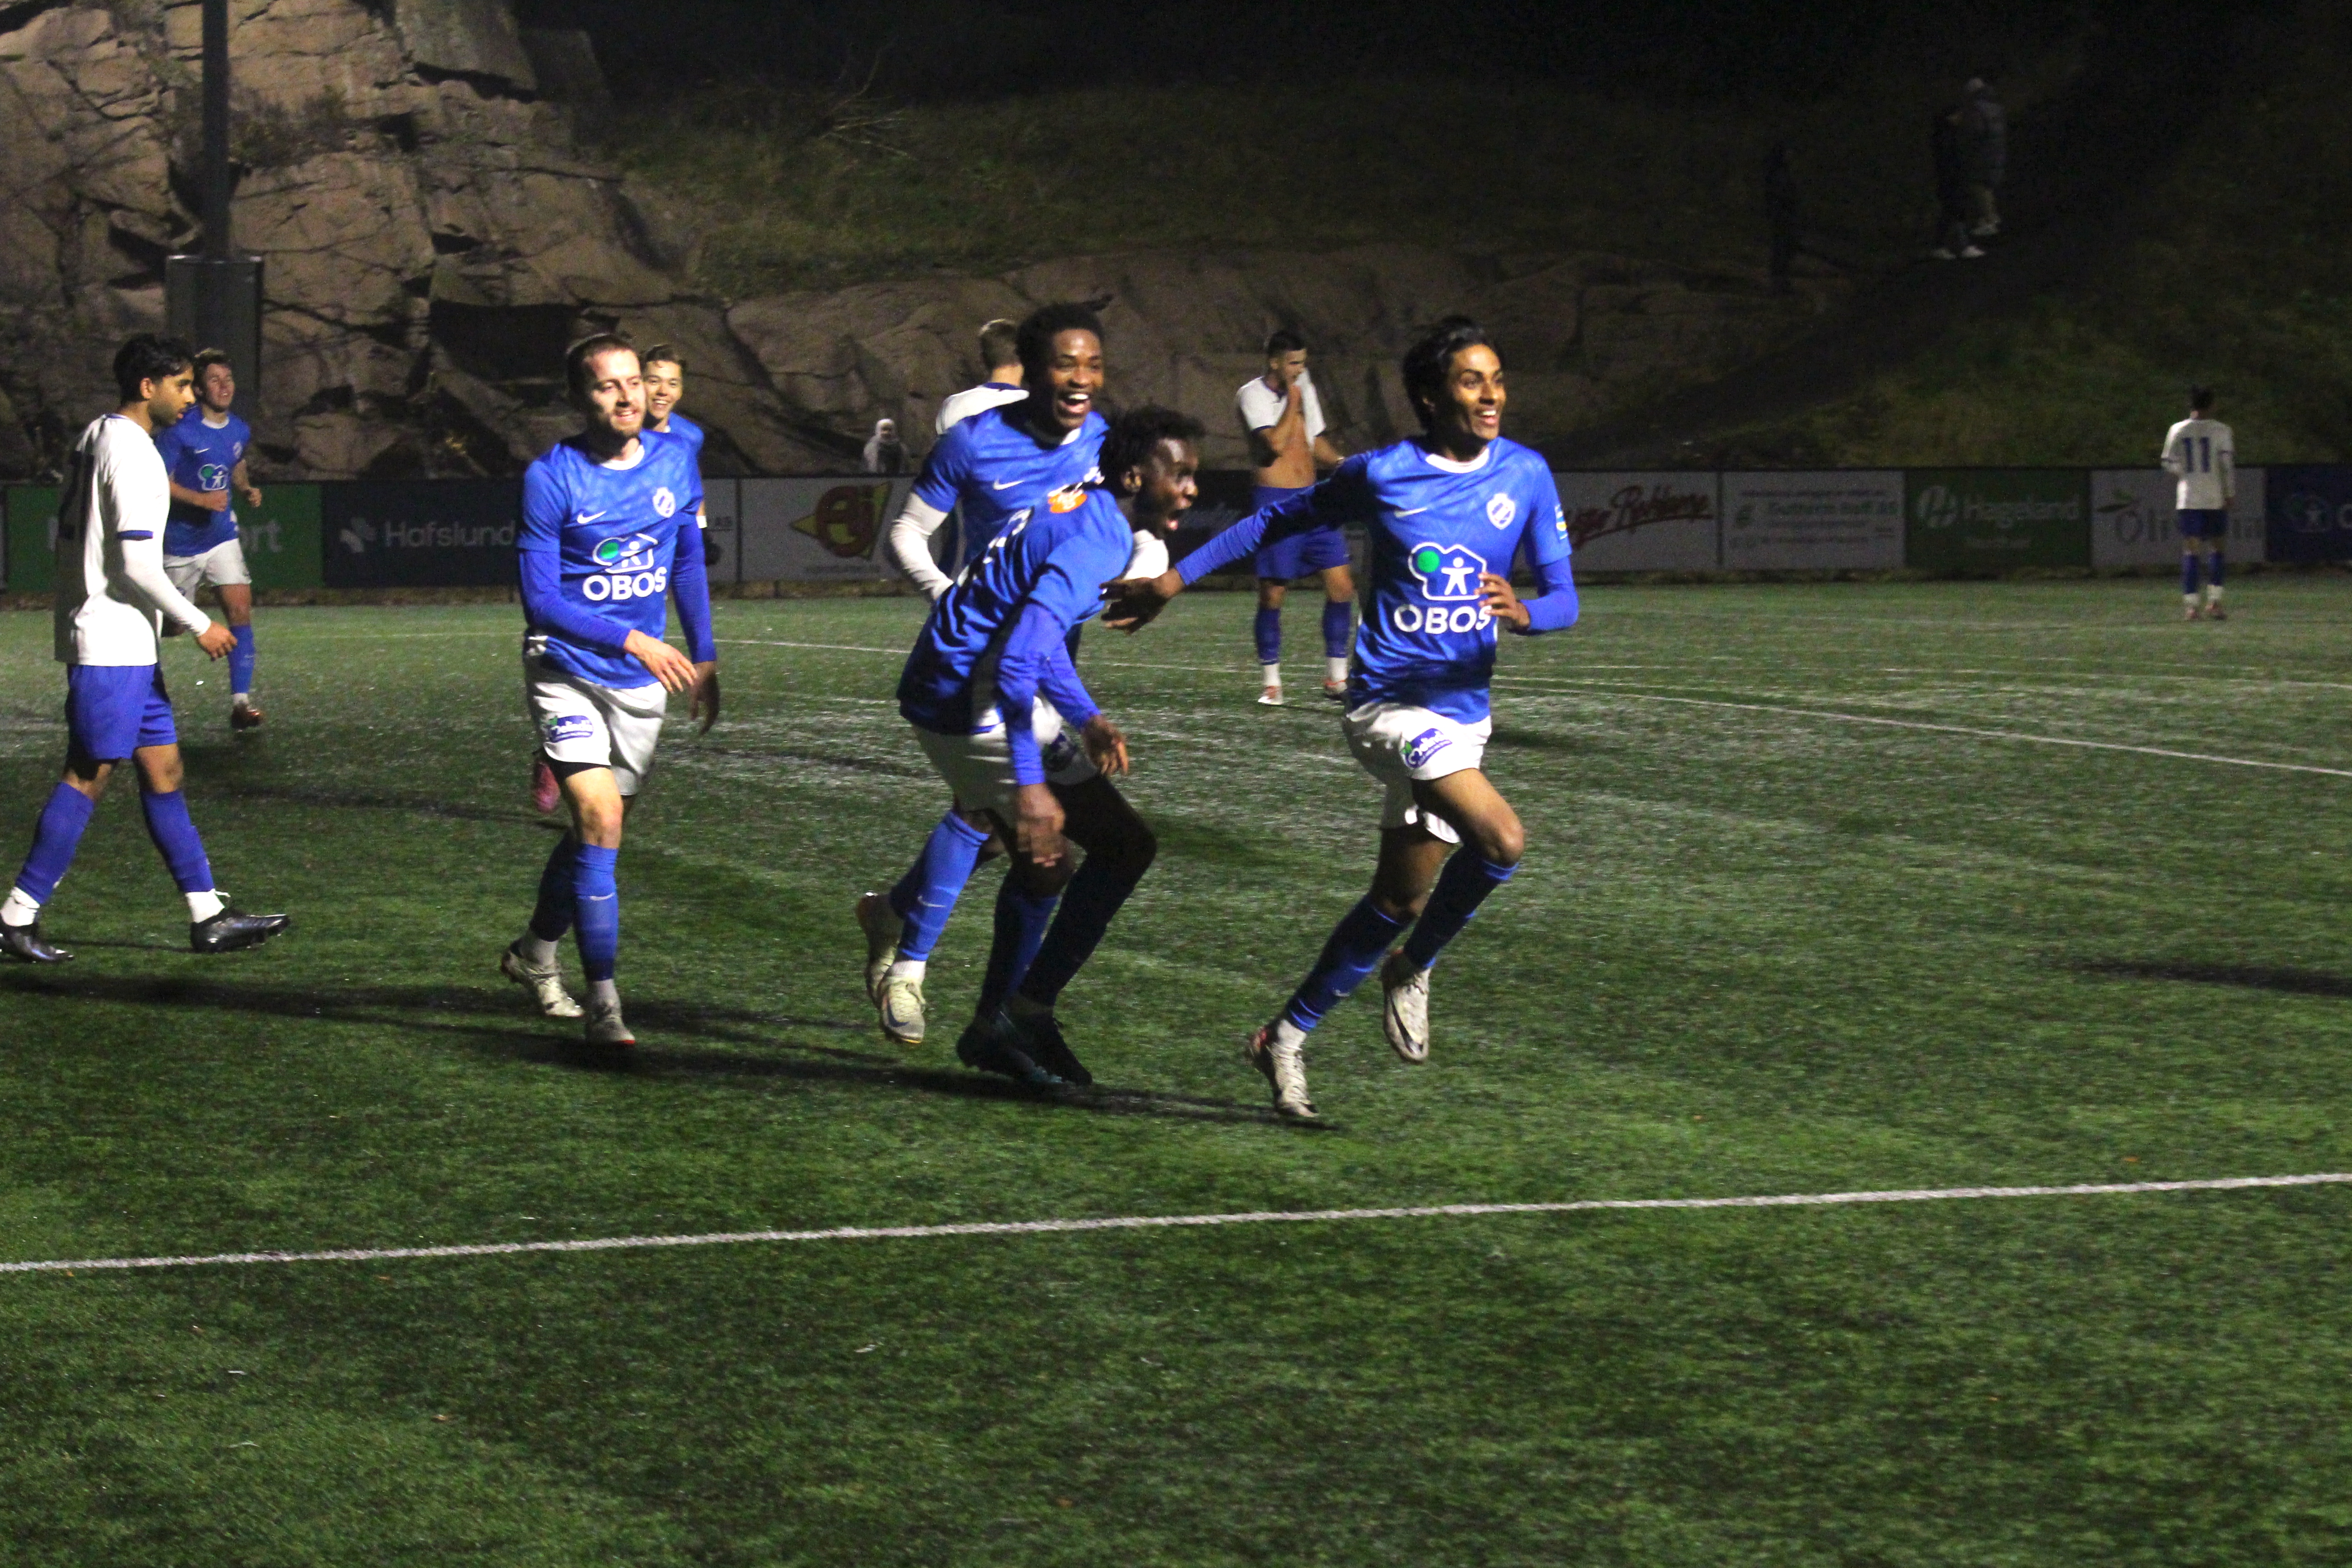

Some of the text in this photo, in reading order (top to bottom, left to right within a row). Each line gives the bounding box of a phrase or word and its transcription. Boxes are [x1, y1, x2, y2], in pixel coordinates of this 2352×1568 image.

[2183, 436, 2210, 473] 11
[384, 520, 516, 548] Hafslund
[583, 566, 667, 601] OBOS
[1394, 603, 1493, 635] OBOS
